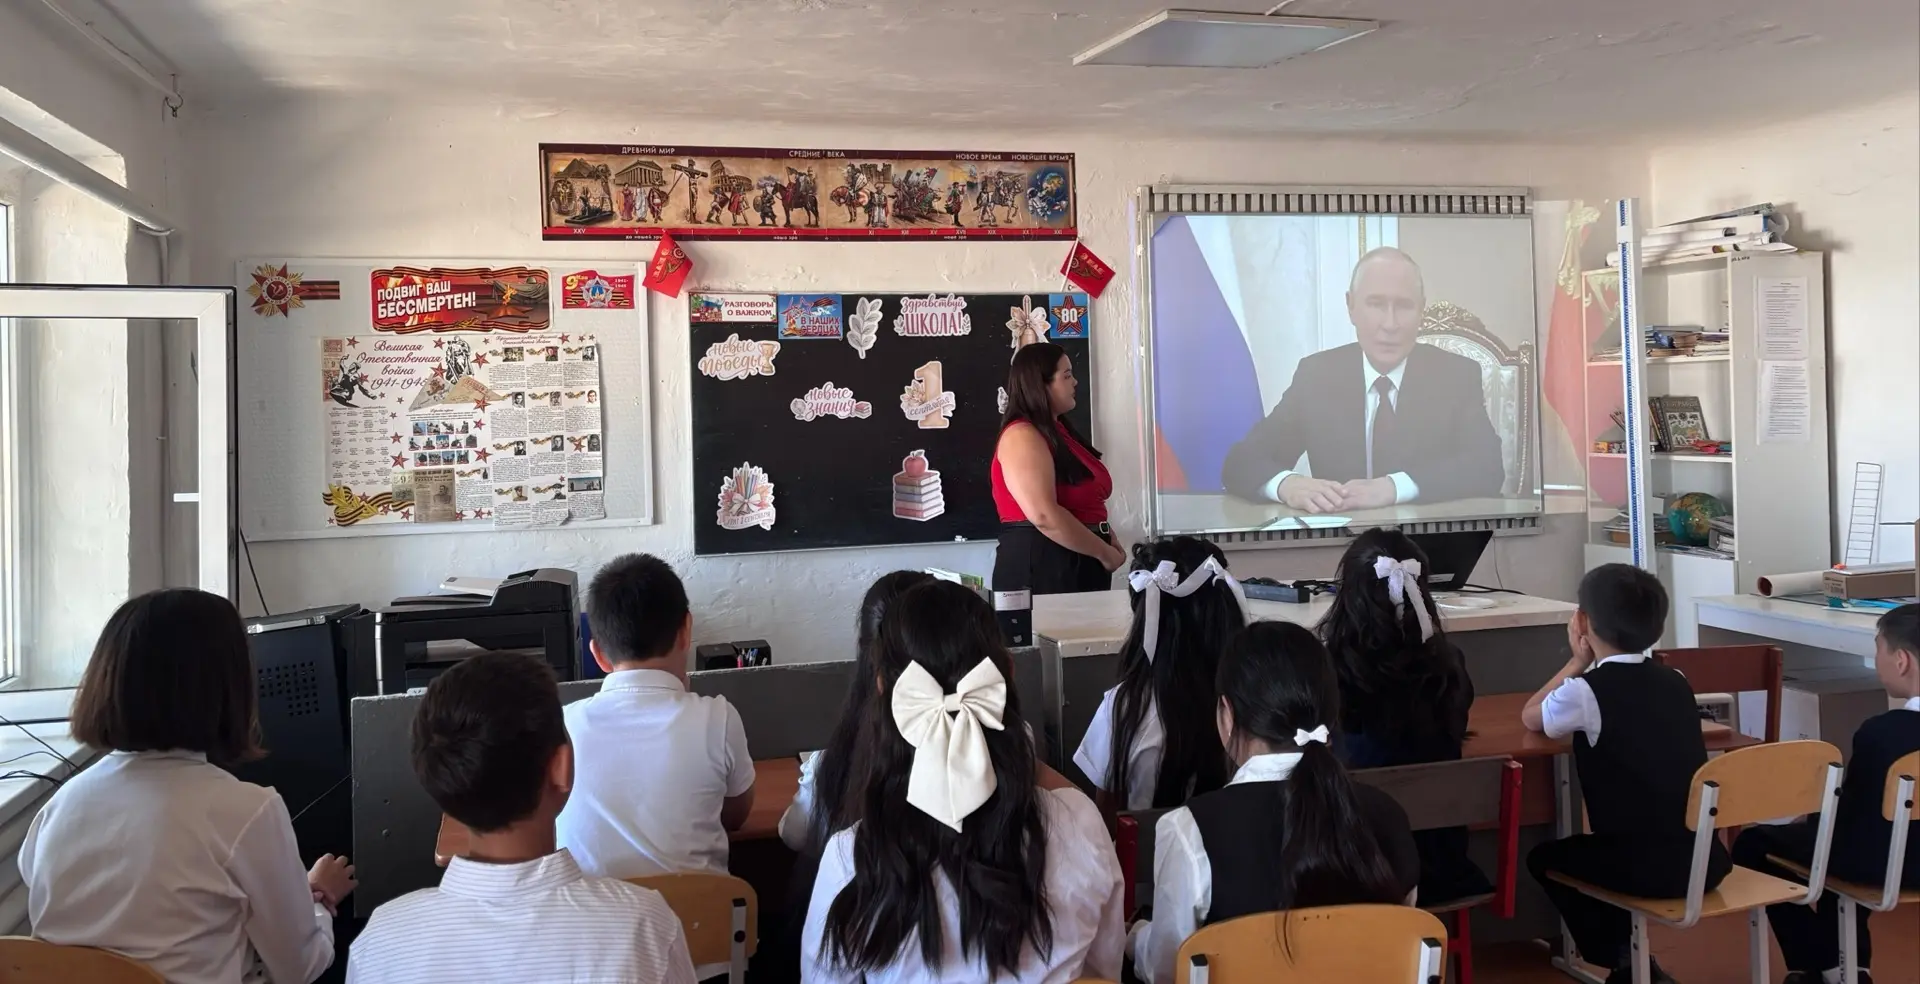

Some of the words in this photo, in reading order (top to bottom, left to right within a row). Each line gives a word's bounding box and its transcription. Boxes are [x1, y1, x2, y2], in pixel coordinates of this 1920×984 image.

[621, 146, 657, 154] ДРЕВНИЙ
[658, 147, 675, 155] МИР
[788, 150, 821, 158] СРЕДНИЕ
[1011, 153, 1047, 161] НОВЕЙШЕЕ
[565, 275, 578, 290] 9
[377, 285, 423, 302] ПОДВИГ
[426, 280, 451, 295] ВАШ
[377, 291, 476, 319] БЕССМЕРТЕН!
[735, 309, 773, 317] ВАЖНОМ
[1061, 308, 1078, 323] 80
[800, 316, 807, 324] В
[808, 316, 840, 324] НАШИХ
[904, 311, 962, 335] ШКОЛА!
[800, 325, 840, 336] СЕРДЦАХ
[373, 340, 424, 352] Великая
[356, 352, 442, 364] Отечественная
[380, 365, 416, 376] война
[809, 383, 850, 401] новые
[914, 363, 949, 427] 1
[909, 396, 950, 416] сентября
